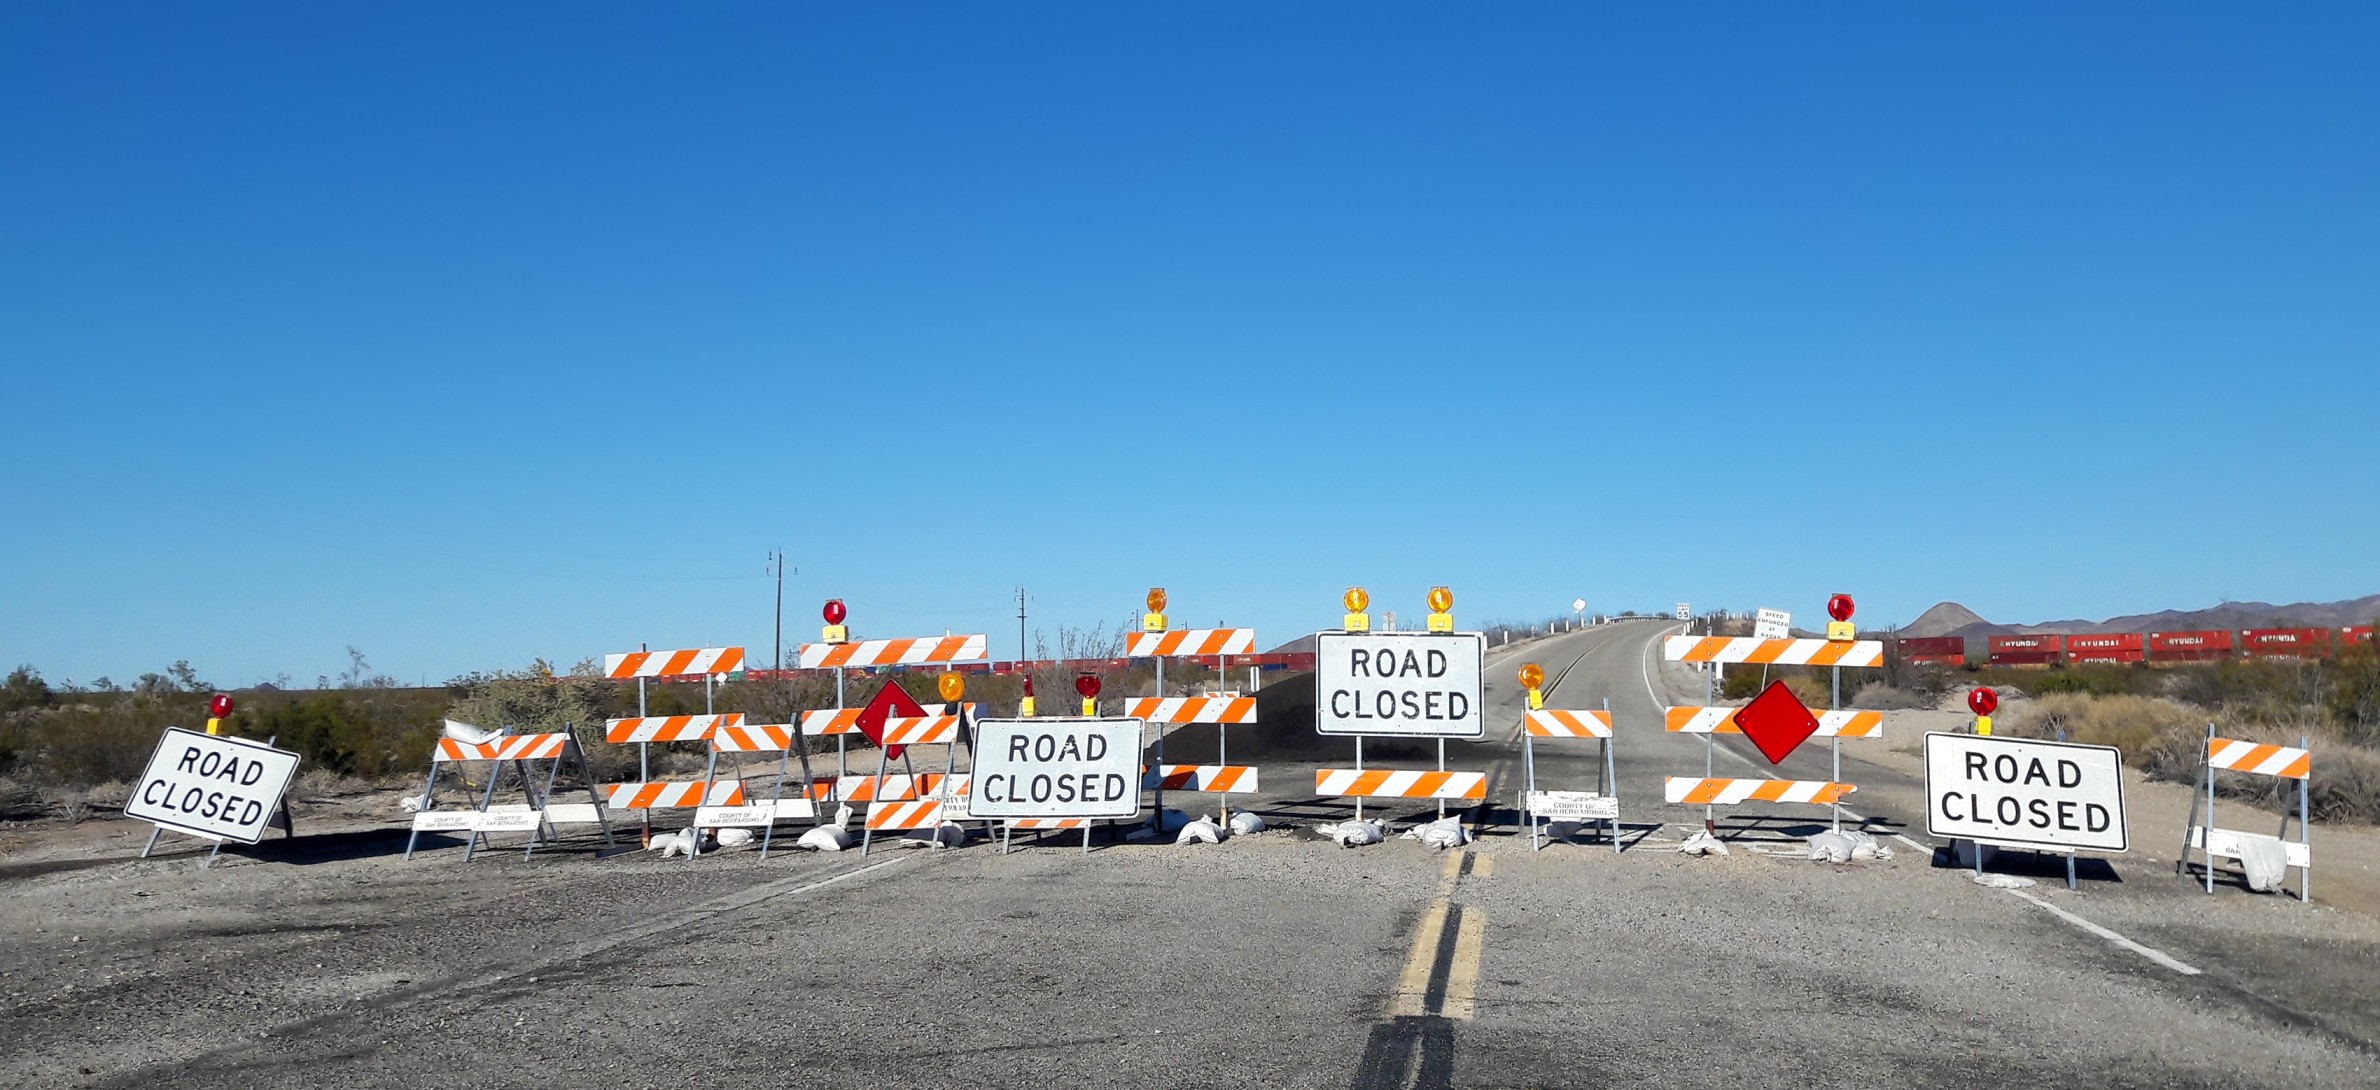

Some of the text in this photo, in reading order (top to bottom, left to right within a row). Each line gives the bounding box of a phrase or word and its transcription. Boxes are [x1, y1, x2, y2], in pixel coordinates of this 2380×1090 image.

[1758, 618, 1788, 627] ENFORCED
[2169, 637, 2204, 645] HYUNDAI
[1351, 648, 1447, 678] ROAD
[1331, 689, 1469, 720] CLOSED
[1008, 733, 1107, 762] ROAD
[177, 746, 264, 786] ROAD
[1965, 751, 2082, 788] ROAD
[143, 779, 263, 826] CLOSED
[984, 773, 1125, 803] CLOSED
[1559, 808, 1608, 816] BERNARDINO
[1941, 791, 2111, 833] CLOSED
